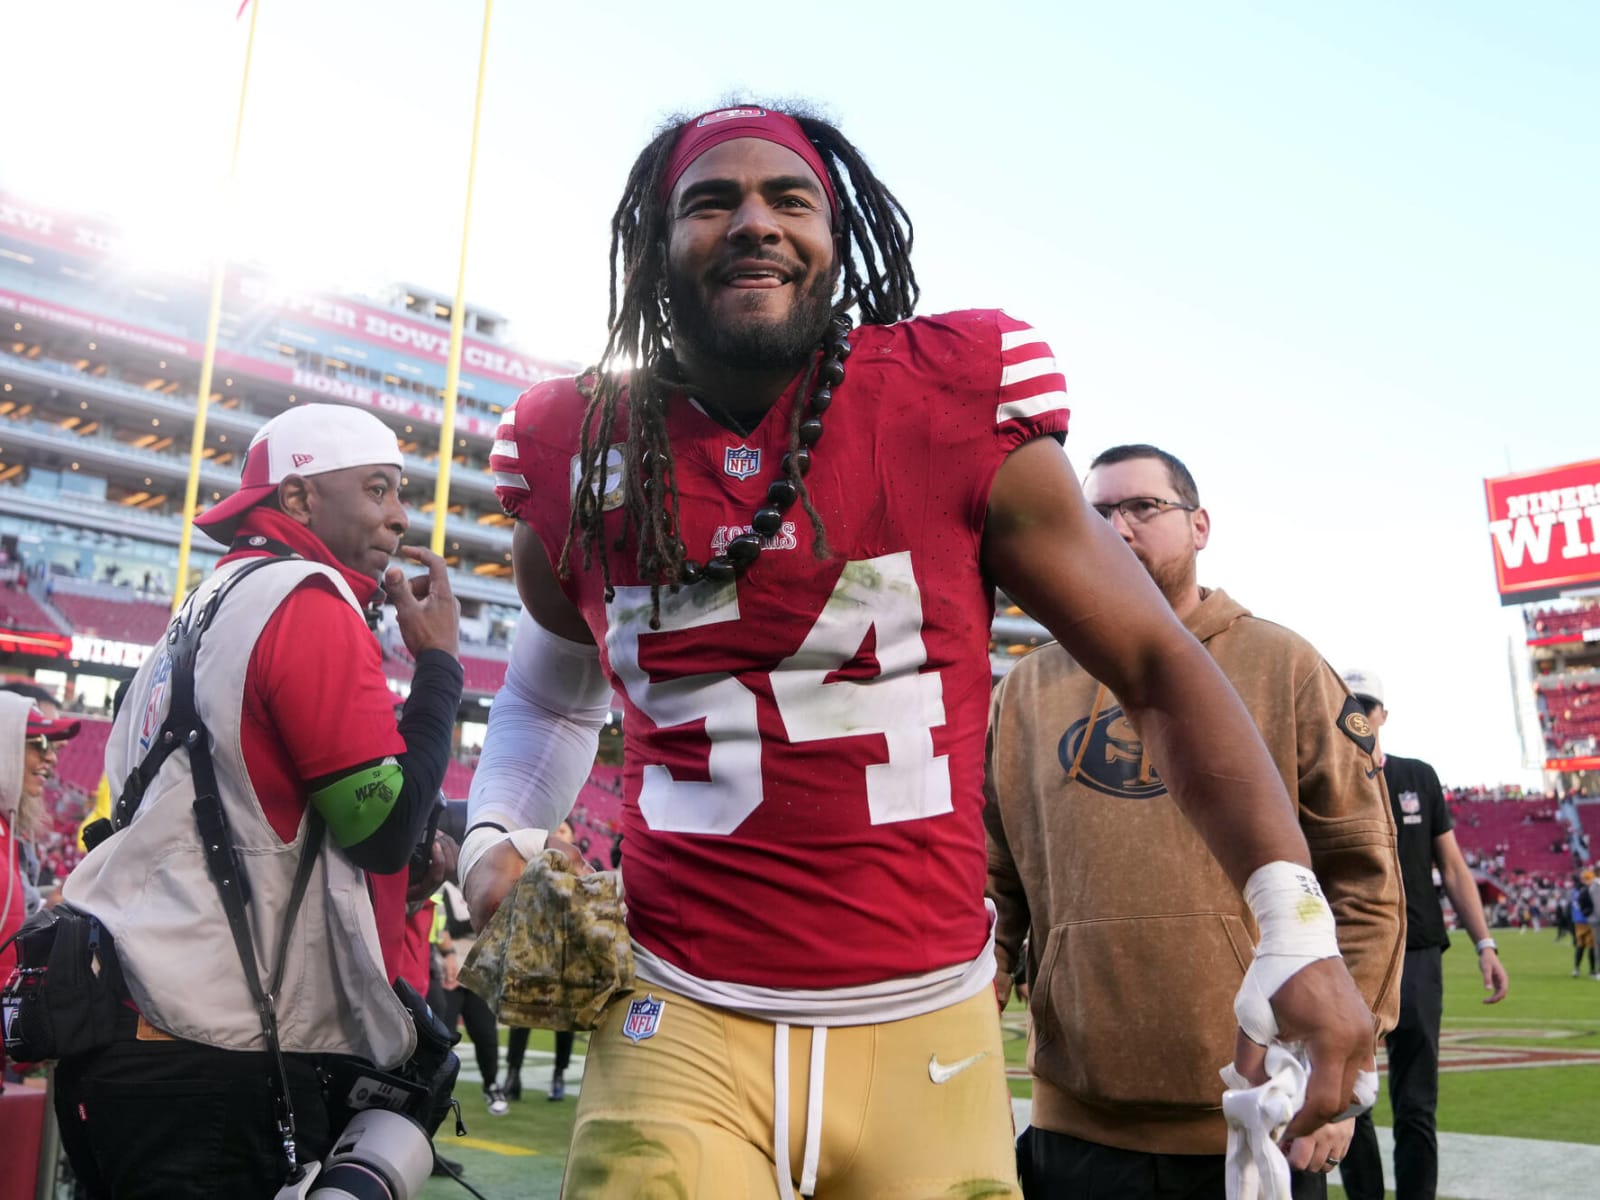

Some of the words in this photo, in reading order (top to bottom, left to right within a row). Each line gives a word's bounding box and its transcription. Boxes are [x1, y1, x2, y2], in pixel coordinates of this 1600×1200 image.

[292, 369, 373, 401] HOME
[729, 458, 756, 474] NFL
[605, 550, 955, 837] 54
[628, 1015, 653, 1034] NFL
